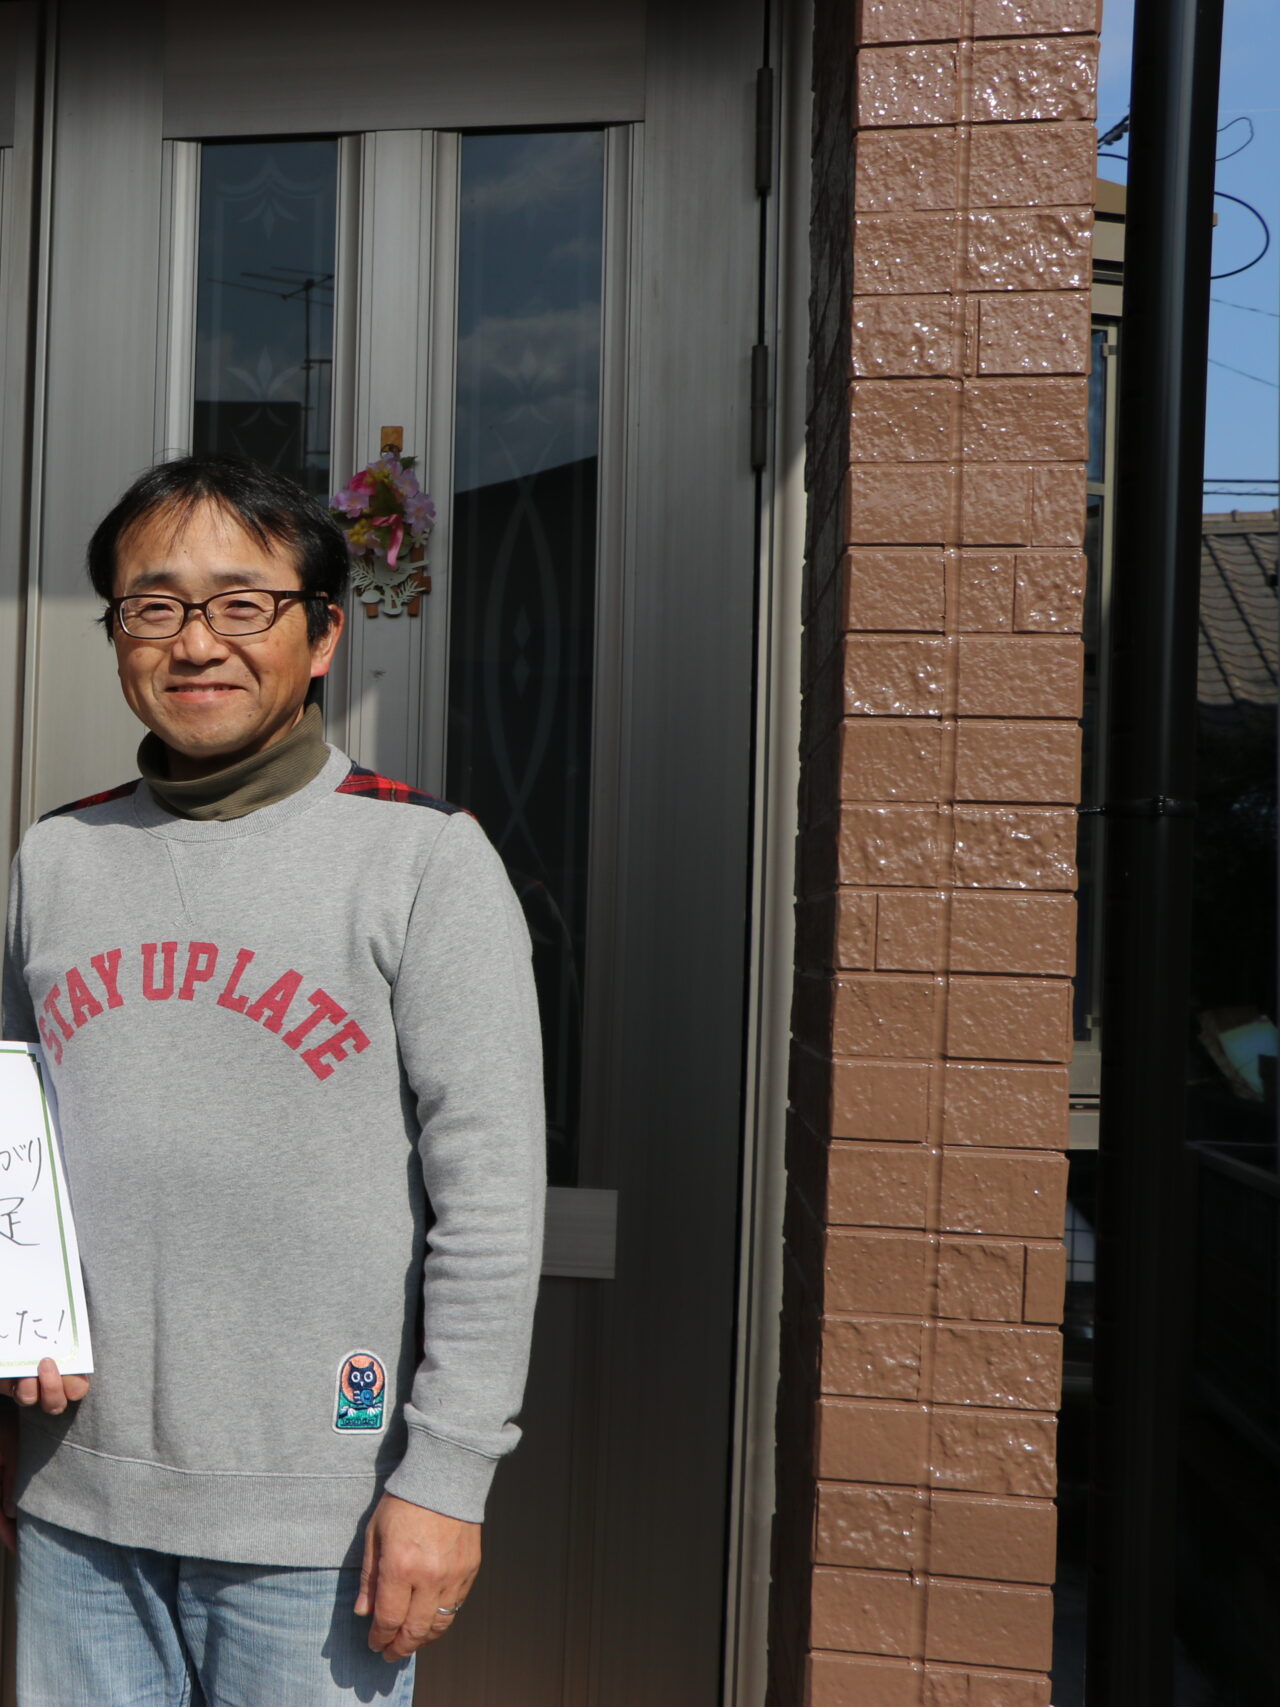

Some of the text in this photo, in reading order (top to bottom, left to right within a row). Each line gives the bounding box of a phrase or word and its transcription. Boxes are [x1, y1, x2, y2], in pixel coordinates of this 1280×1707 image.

[38, 941, 372, 1081] STAY UP LATE
